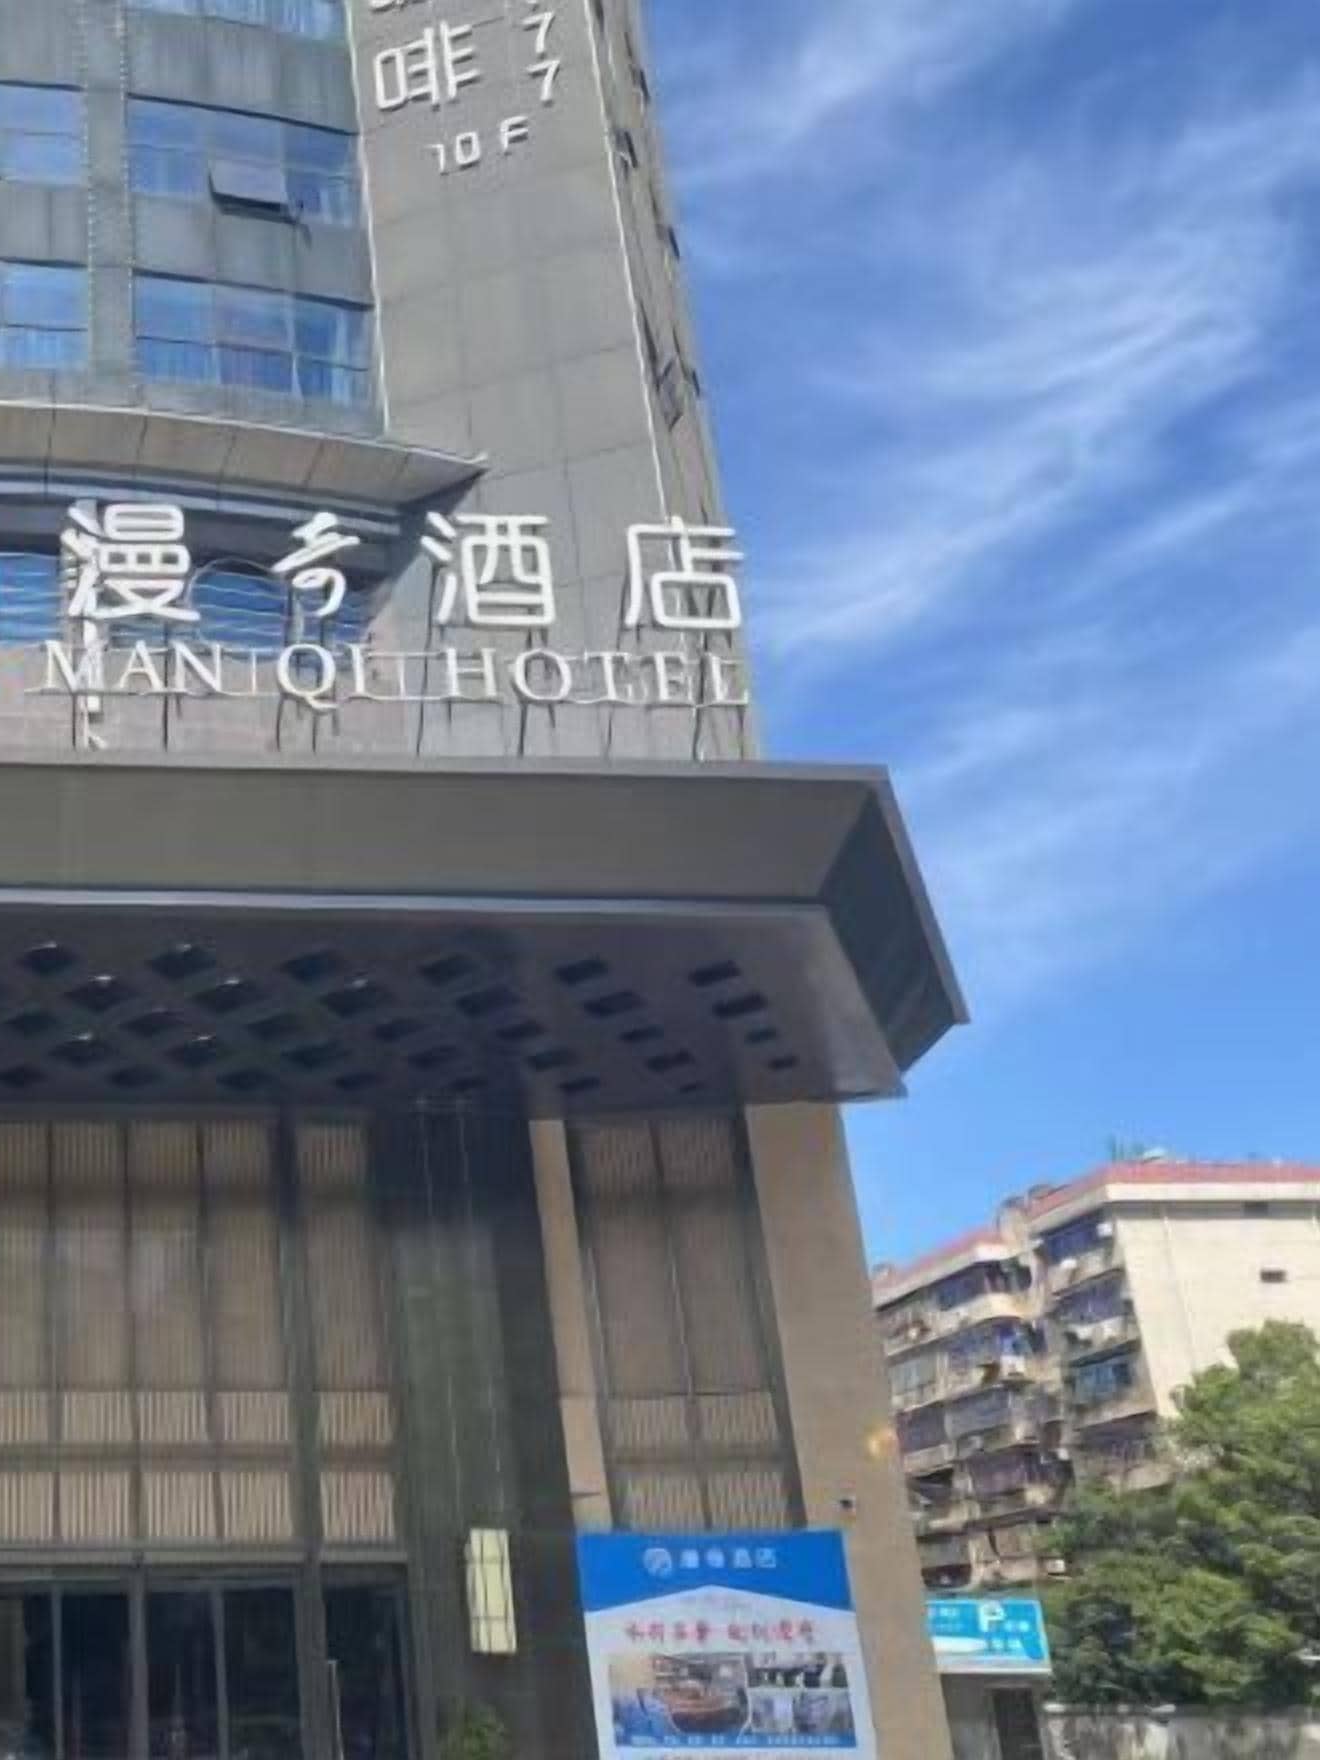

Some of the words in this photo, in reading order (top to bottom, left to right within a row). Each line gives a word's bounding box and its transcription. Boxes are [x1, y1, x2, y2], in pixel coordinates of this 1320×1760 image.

[370, 0, 481, 110] 啡
[60, 500, 744, 628] 漫奇酒店
[40, 639, 222, 692] MAN
[440, 647, 750, 706] HOTEL
